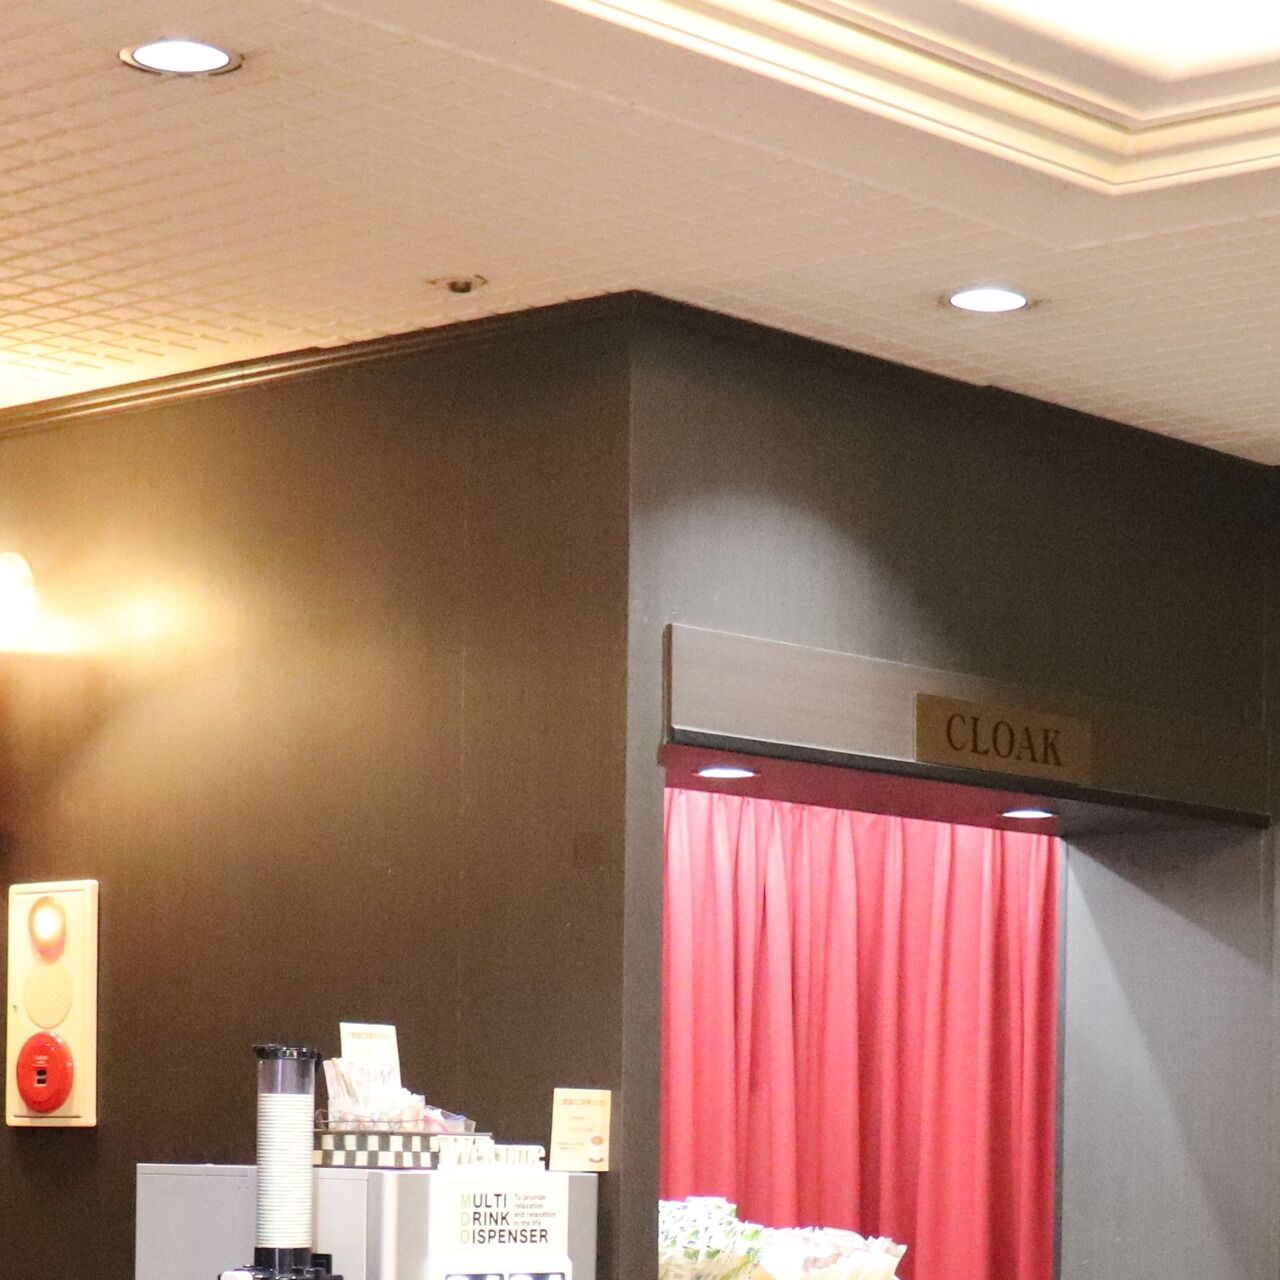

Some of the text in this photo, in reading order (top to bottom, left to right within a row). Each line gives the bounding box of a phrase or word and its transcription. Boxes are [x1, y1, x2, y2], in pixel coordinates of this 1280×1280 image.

[946, 713, 1063, 767] CLOAK
[460, 1193, 507, 1208] MULTI
[460, 1211, 510, 1226] DRINK
[460, 1229, 549, 1244] DISPENSER
